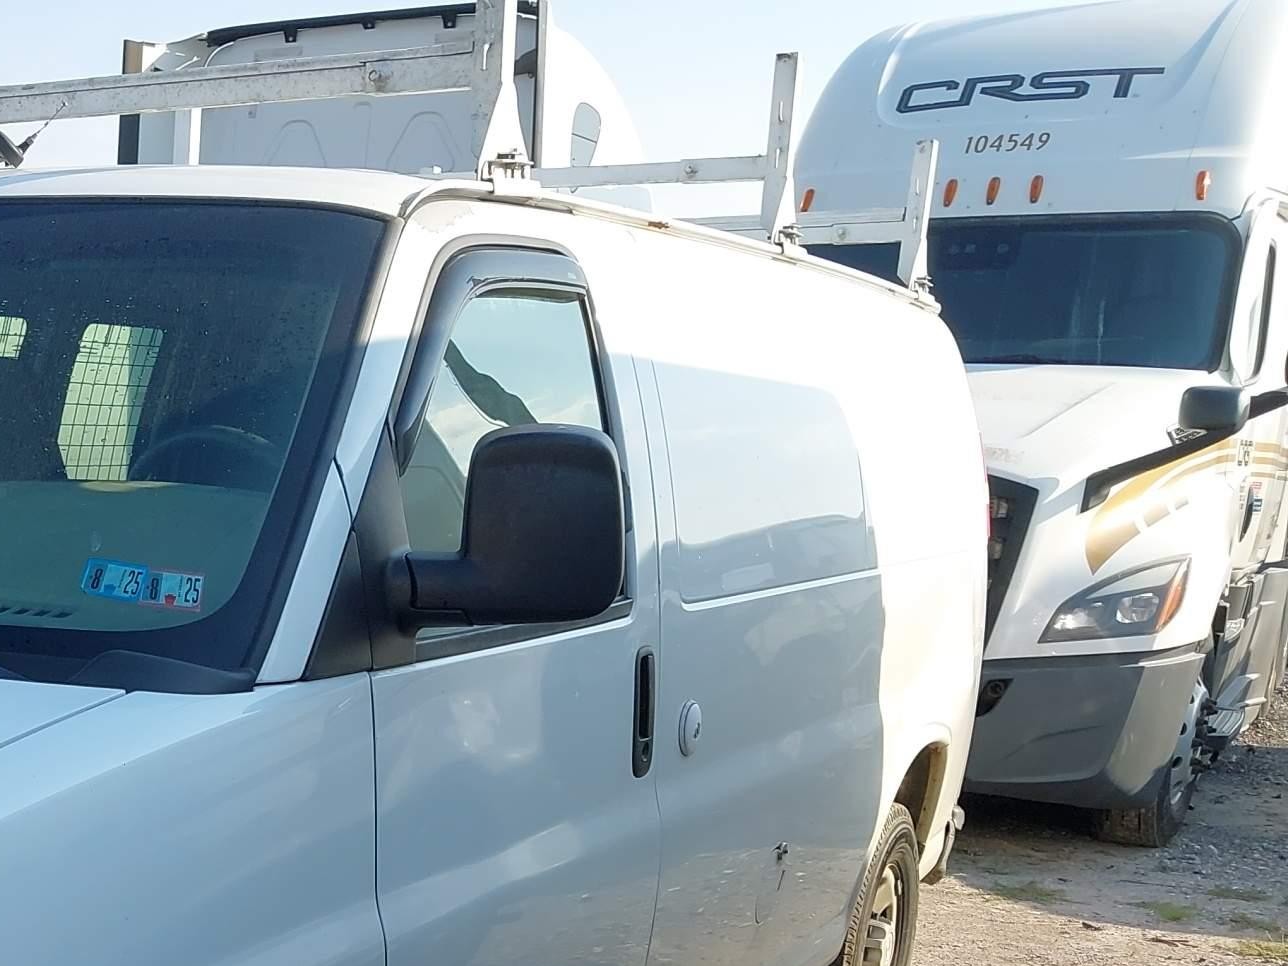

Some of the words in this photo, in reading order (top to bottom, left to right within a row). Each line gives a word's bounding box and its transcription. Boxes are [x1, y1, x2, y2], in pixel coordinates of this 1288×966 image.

[896, 67, 1165, 113] CRST
[964, 132, 1051, 154] 104549
[91, 568, 103, 589] 8
[123, 570, 143, 595] 25
[150, 578, 159, 600] 8
[184, 578, 200, 604] 25
